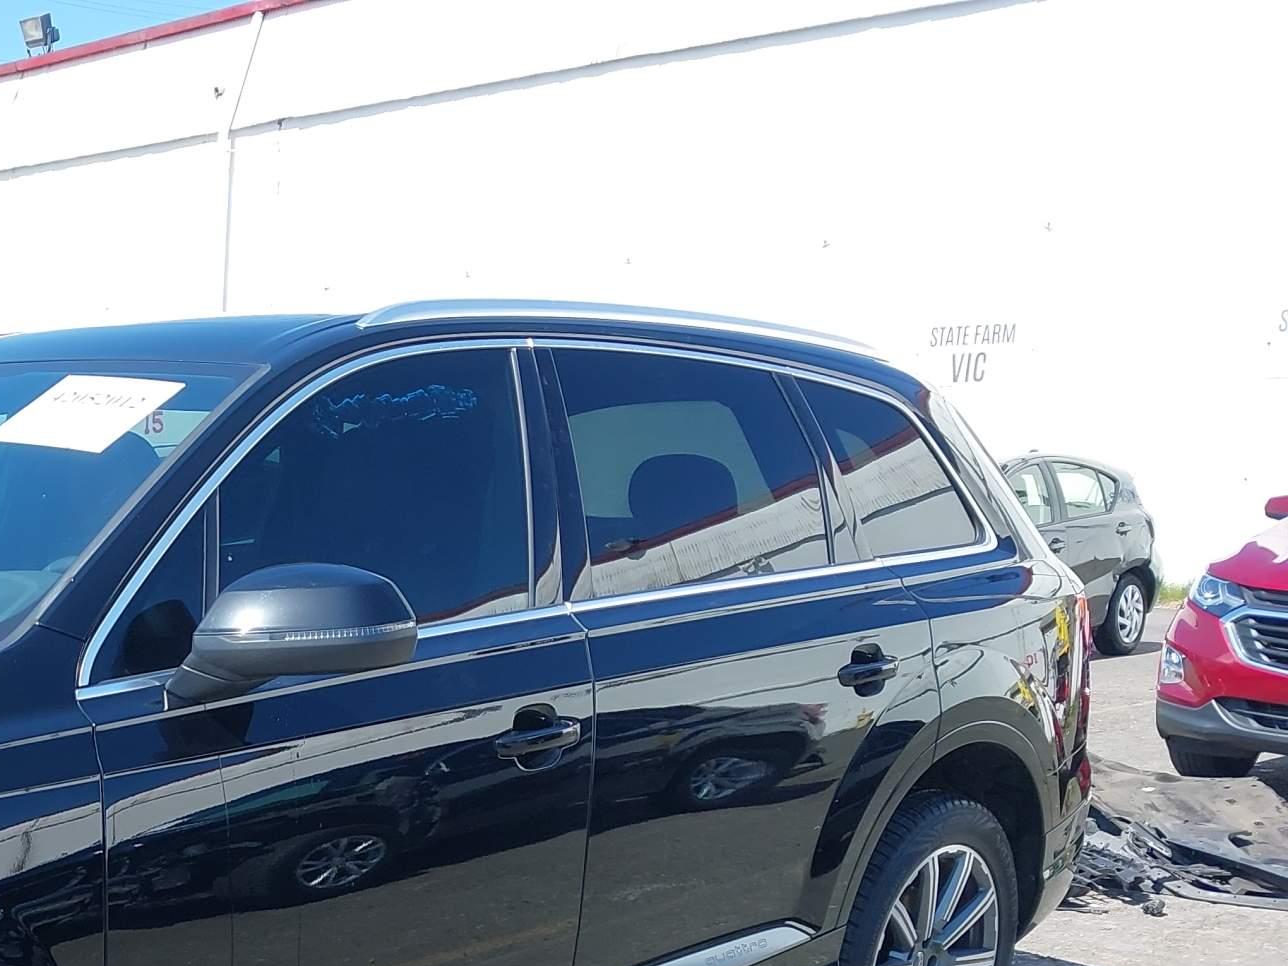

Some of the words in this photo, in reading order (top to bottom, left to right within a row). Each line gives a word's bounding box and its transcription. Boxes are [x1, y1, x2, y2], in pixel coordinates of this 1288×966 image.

[929, 325, 970, 348] STATE
[973, 323, 1017, 345] FARM
[951, 351, 987, 383] VIC
